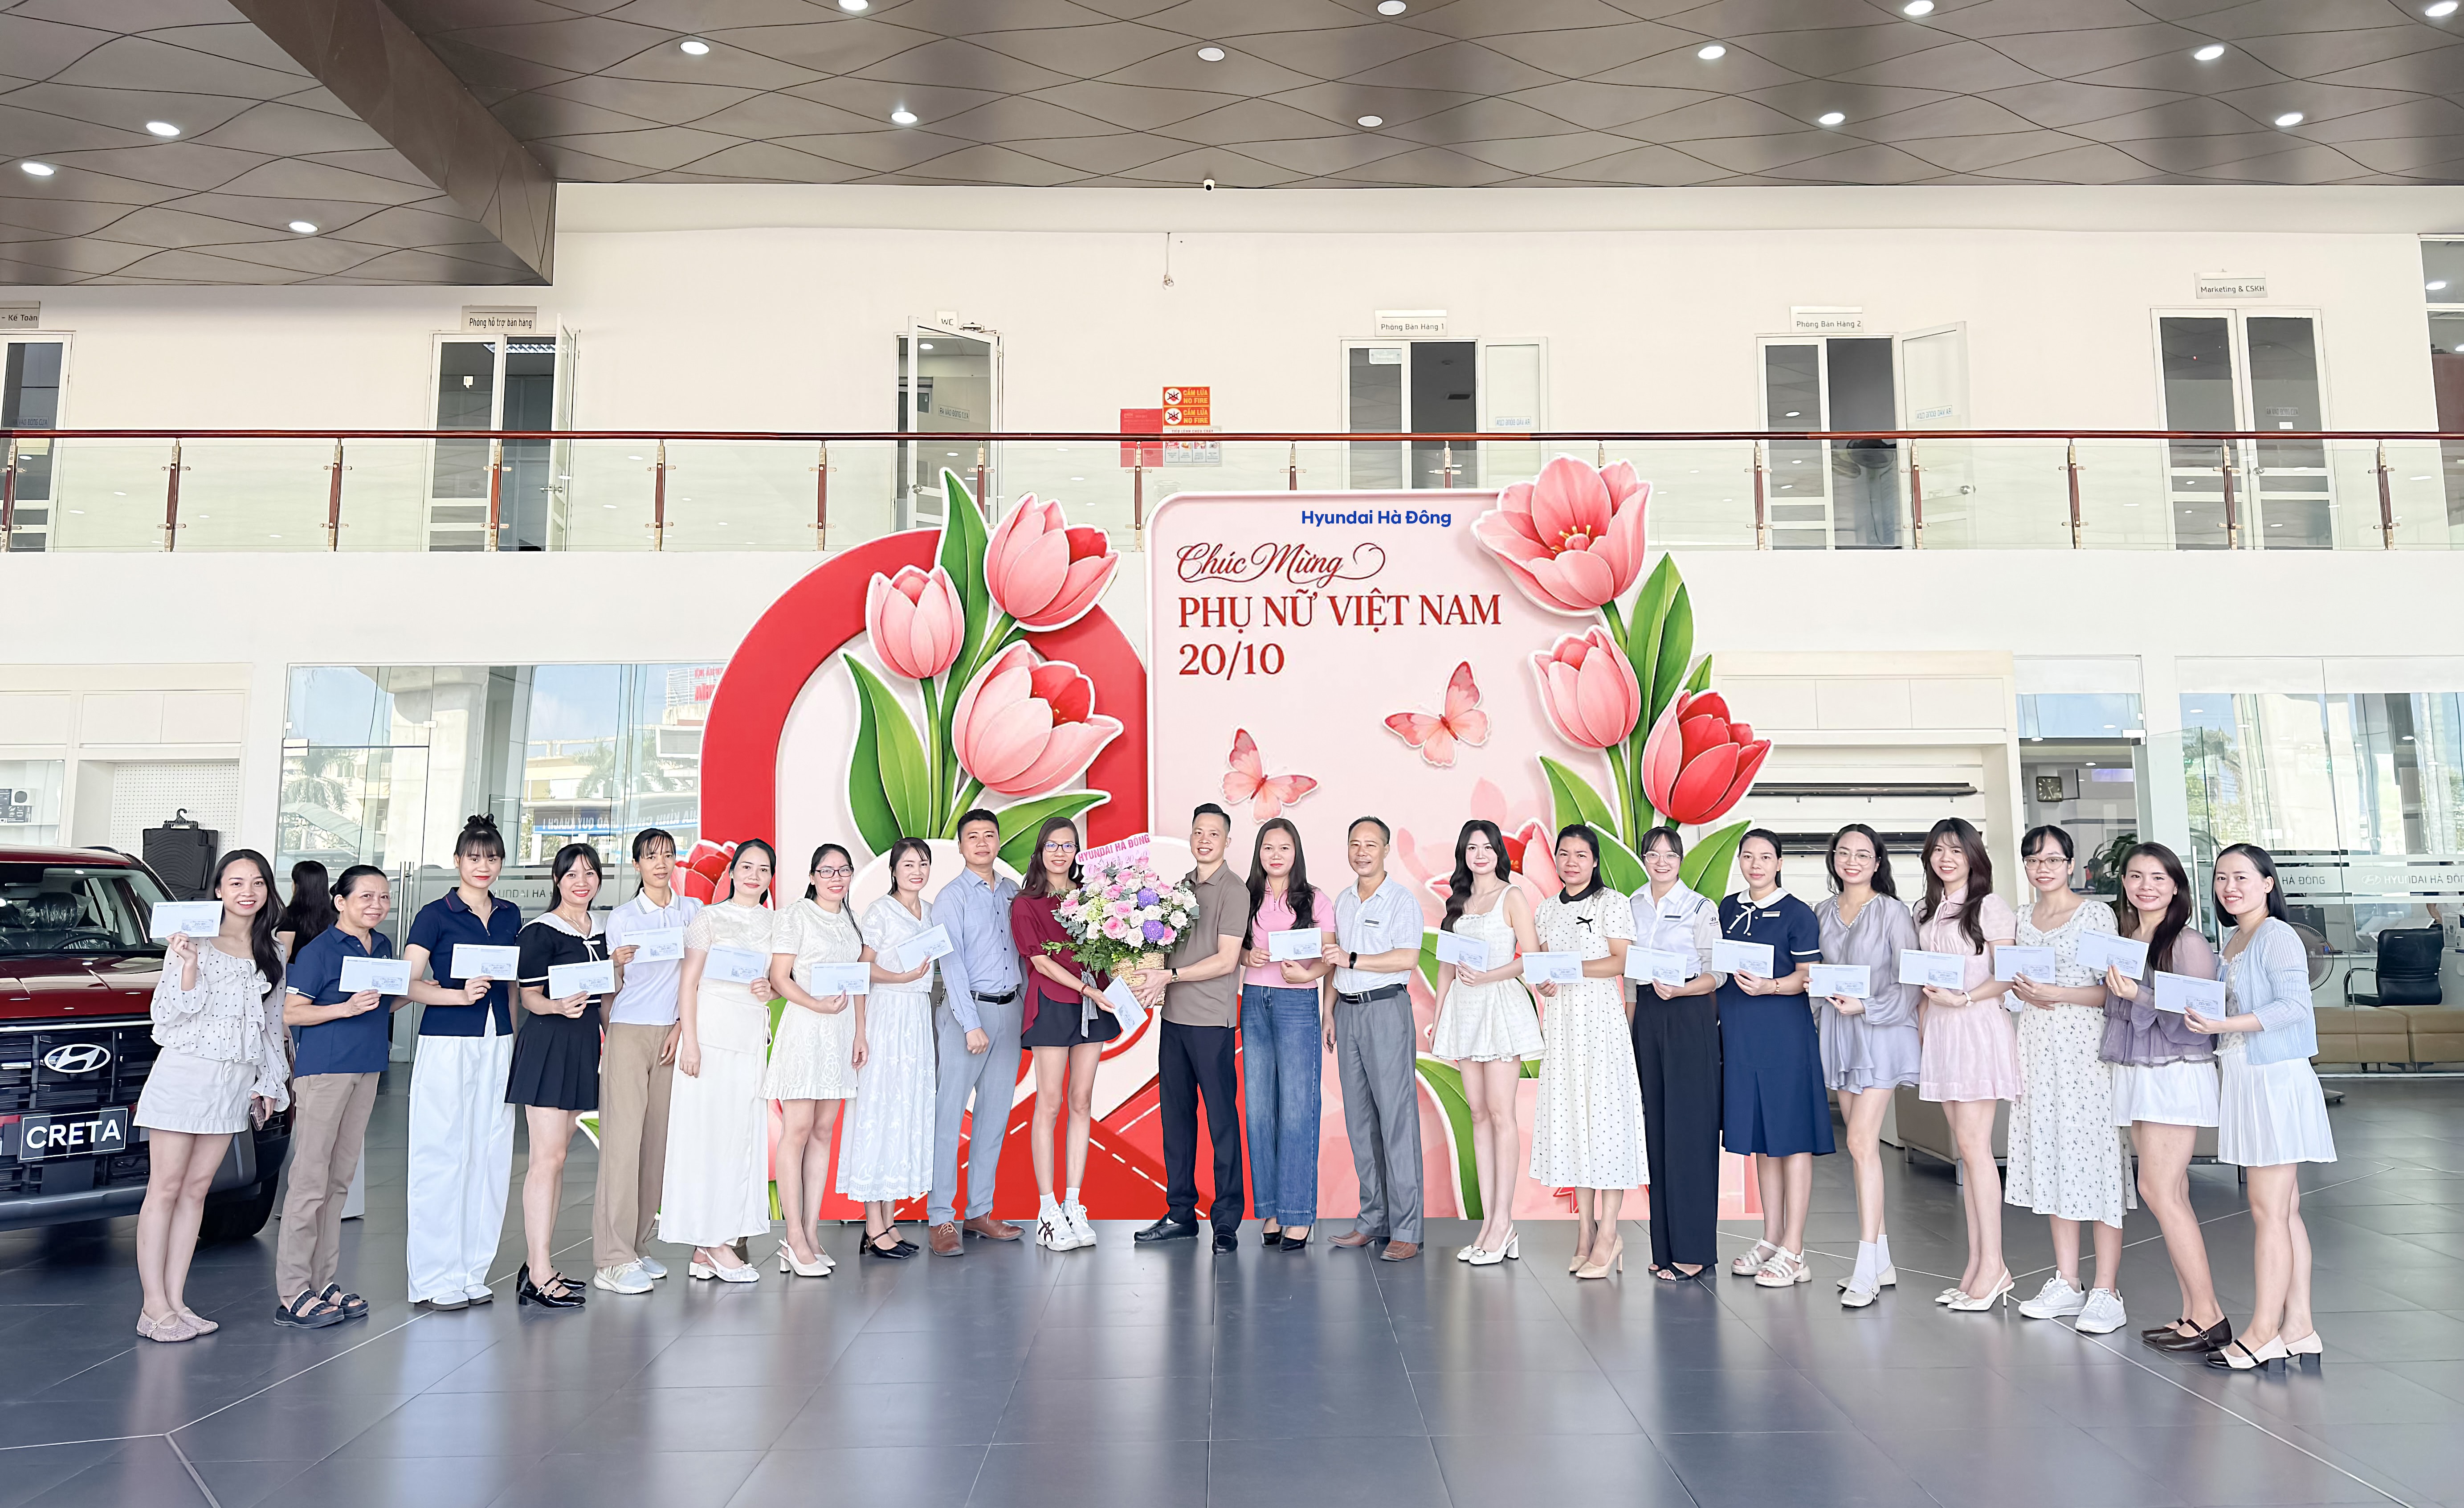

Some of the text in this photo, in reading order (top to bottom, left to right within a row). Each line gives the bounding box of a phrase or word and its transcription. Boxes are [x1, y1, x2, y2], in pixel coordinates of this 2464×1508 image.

[469, 317, 532, 329] Phòng hỗ trợ bán hàng
[1421, 323, 1438, 331] Hàng
[1796, 320, 1819, 329] Phòng
[1183, 388, 1208, 396] CẤM LỬA
[1183, 407, 1208, 416] CẤM LỬA
[1302, 510, 1451, 527] Hyundai Hà Đông
[1177, 543, 1385, 588] Chúc Mừng
[1179, 588, 1501, 633] PHỤ NỮ VIỆT NAM
[1179, 641, 1285, 680] 20/10
[1078, 834, 1151, 862] HYUNDAI HÀ ĐÔNG
[2282, 875, 2325, 885] HÀ ĐÔNG
[2384, 875, 2427, 884] HYUNDAI
[2430, 874, 2444, 884] HÀ
[532, 888, 546, 897] HÀ
[26, 1119, 121, 1149] CRETA
